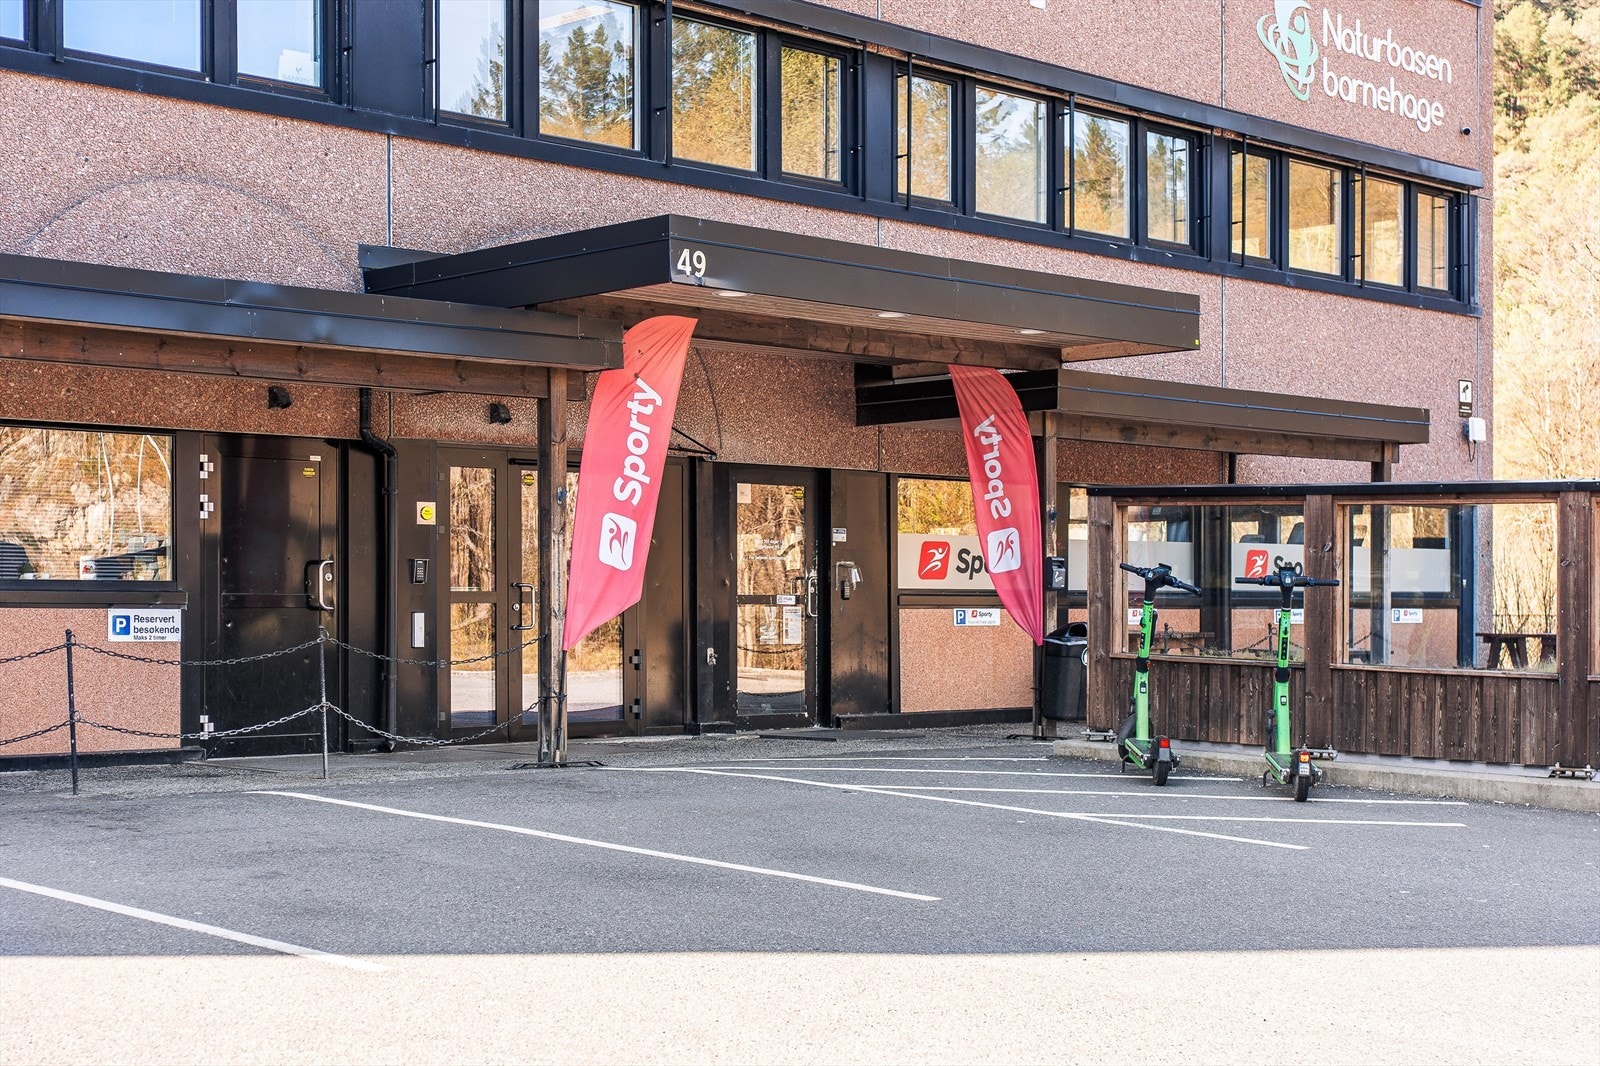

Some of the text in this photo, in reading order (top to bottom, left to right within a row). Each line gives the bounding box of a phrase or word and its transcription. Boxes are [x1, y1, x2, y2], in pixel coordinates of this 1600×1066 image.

[1322, 8, 1452, 84] Naturbasen
[1322, 56, 1445, 132] barnehage
[677, 248, 706, 277] 49
[613, 377, 663, 506] Sporty
[955, 547, 988, 580] Sp
[115, 618, 127, 633] P
[133, 614, 175, 624] Reservert
[133, 625, 180, 634] besøkende
[957, 611, 965, 624] P
